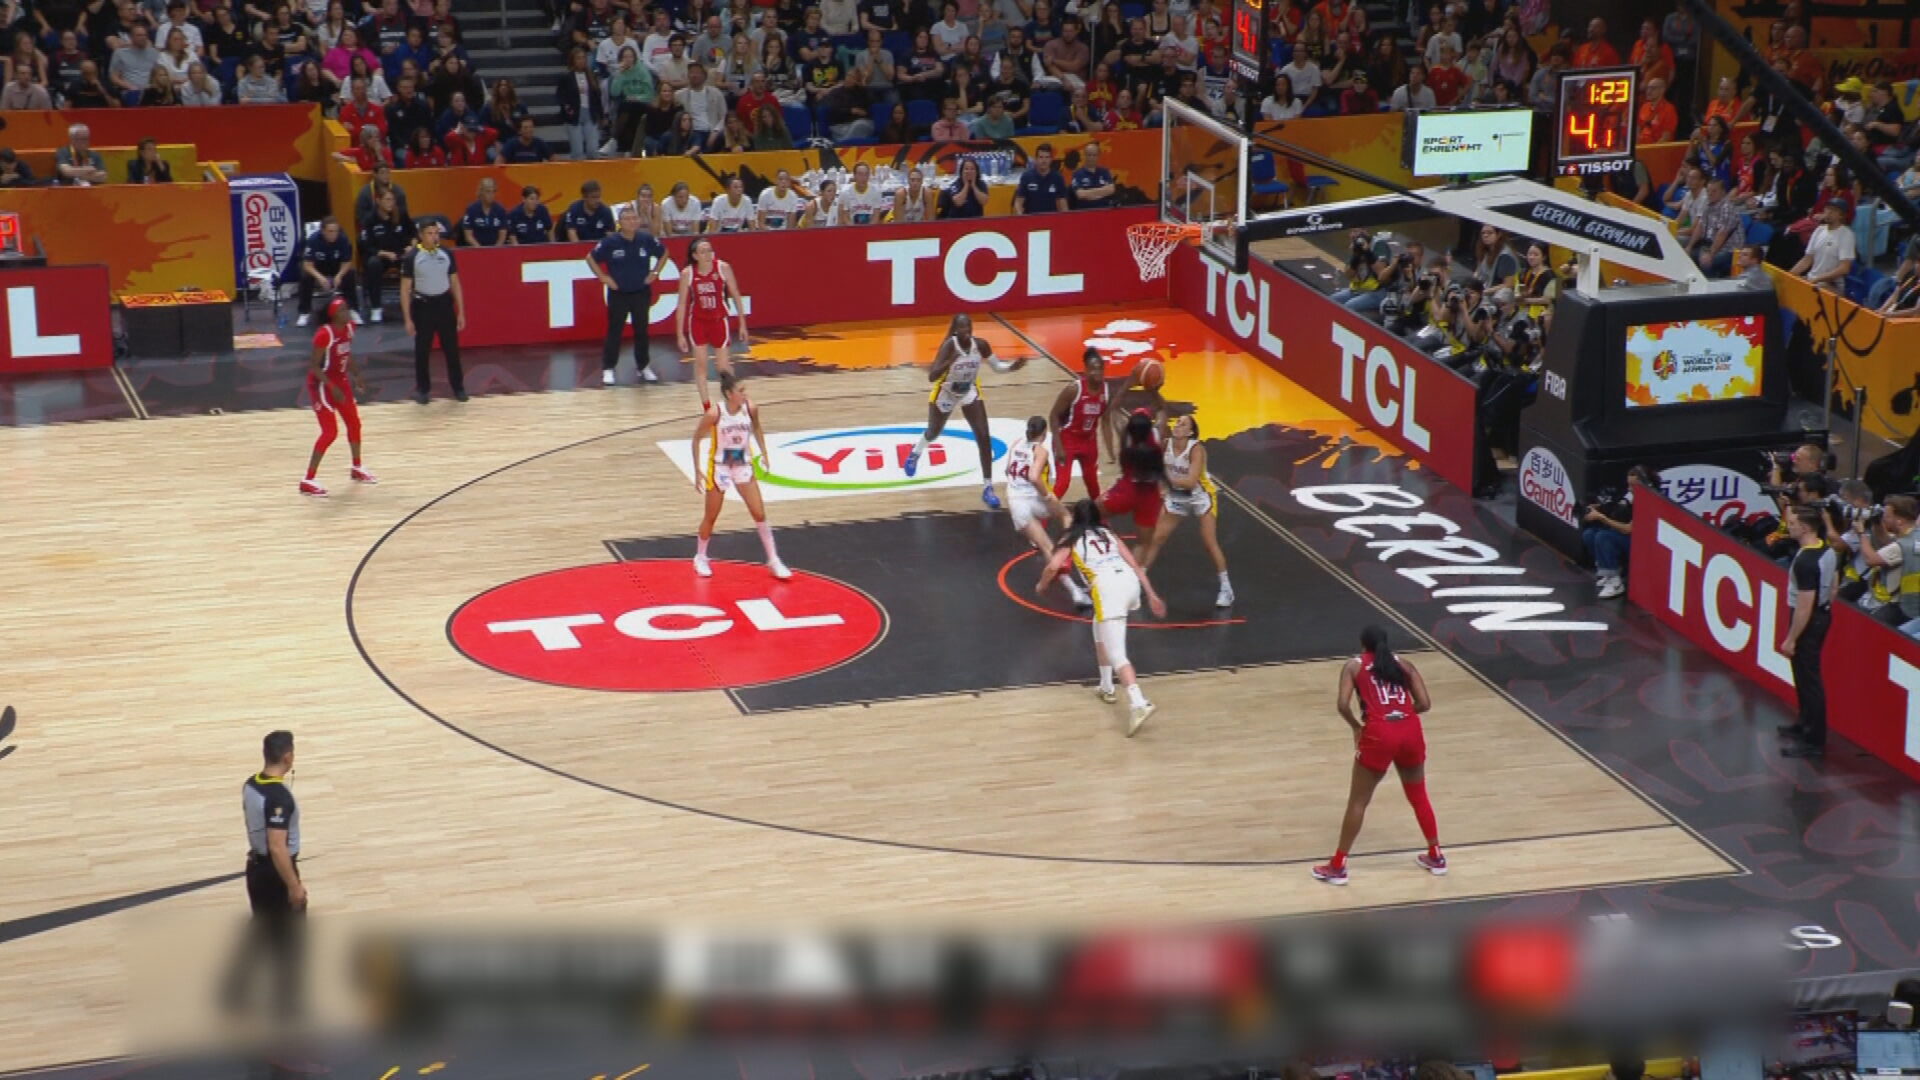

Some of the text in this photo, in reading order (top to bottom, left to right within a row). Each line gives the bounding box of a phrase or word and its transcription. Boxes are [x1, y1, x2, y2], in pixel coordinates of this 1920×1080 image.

[1590, 80, 1629, 104] 1:23
[1578, 159, 1633, 174] TISSOT
[1584, 219, 1649, 250] GERMANY
[866, 230, 1085, 305] TCL
[1199, 251, 1284, 360] TCL
[1331, 321, 1430, 453] TCL
[1544, 370, 1567, 400] FIBA
[1290, 483, 1608, 633] BERLIN
[486, 597, 845, 652] TCL
[1657, 518, 1796, 689] TCL
